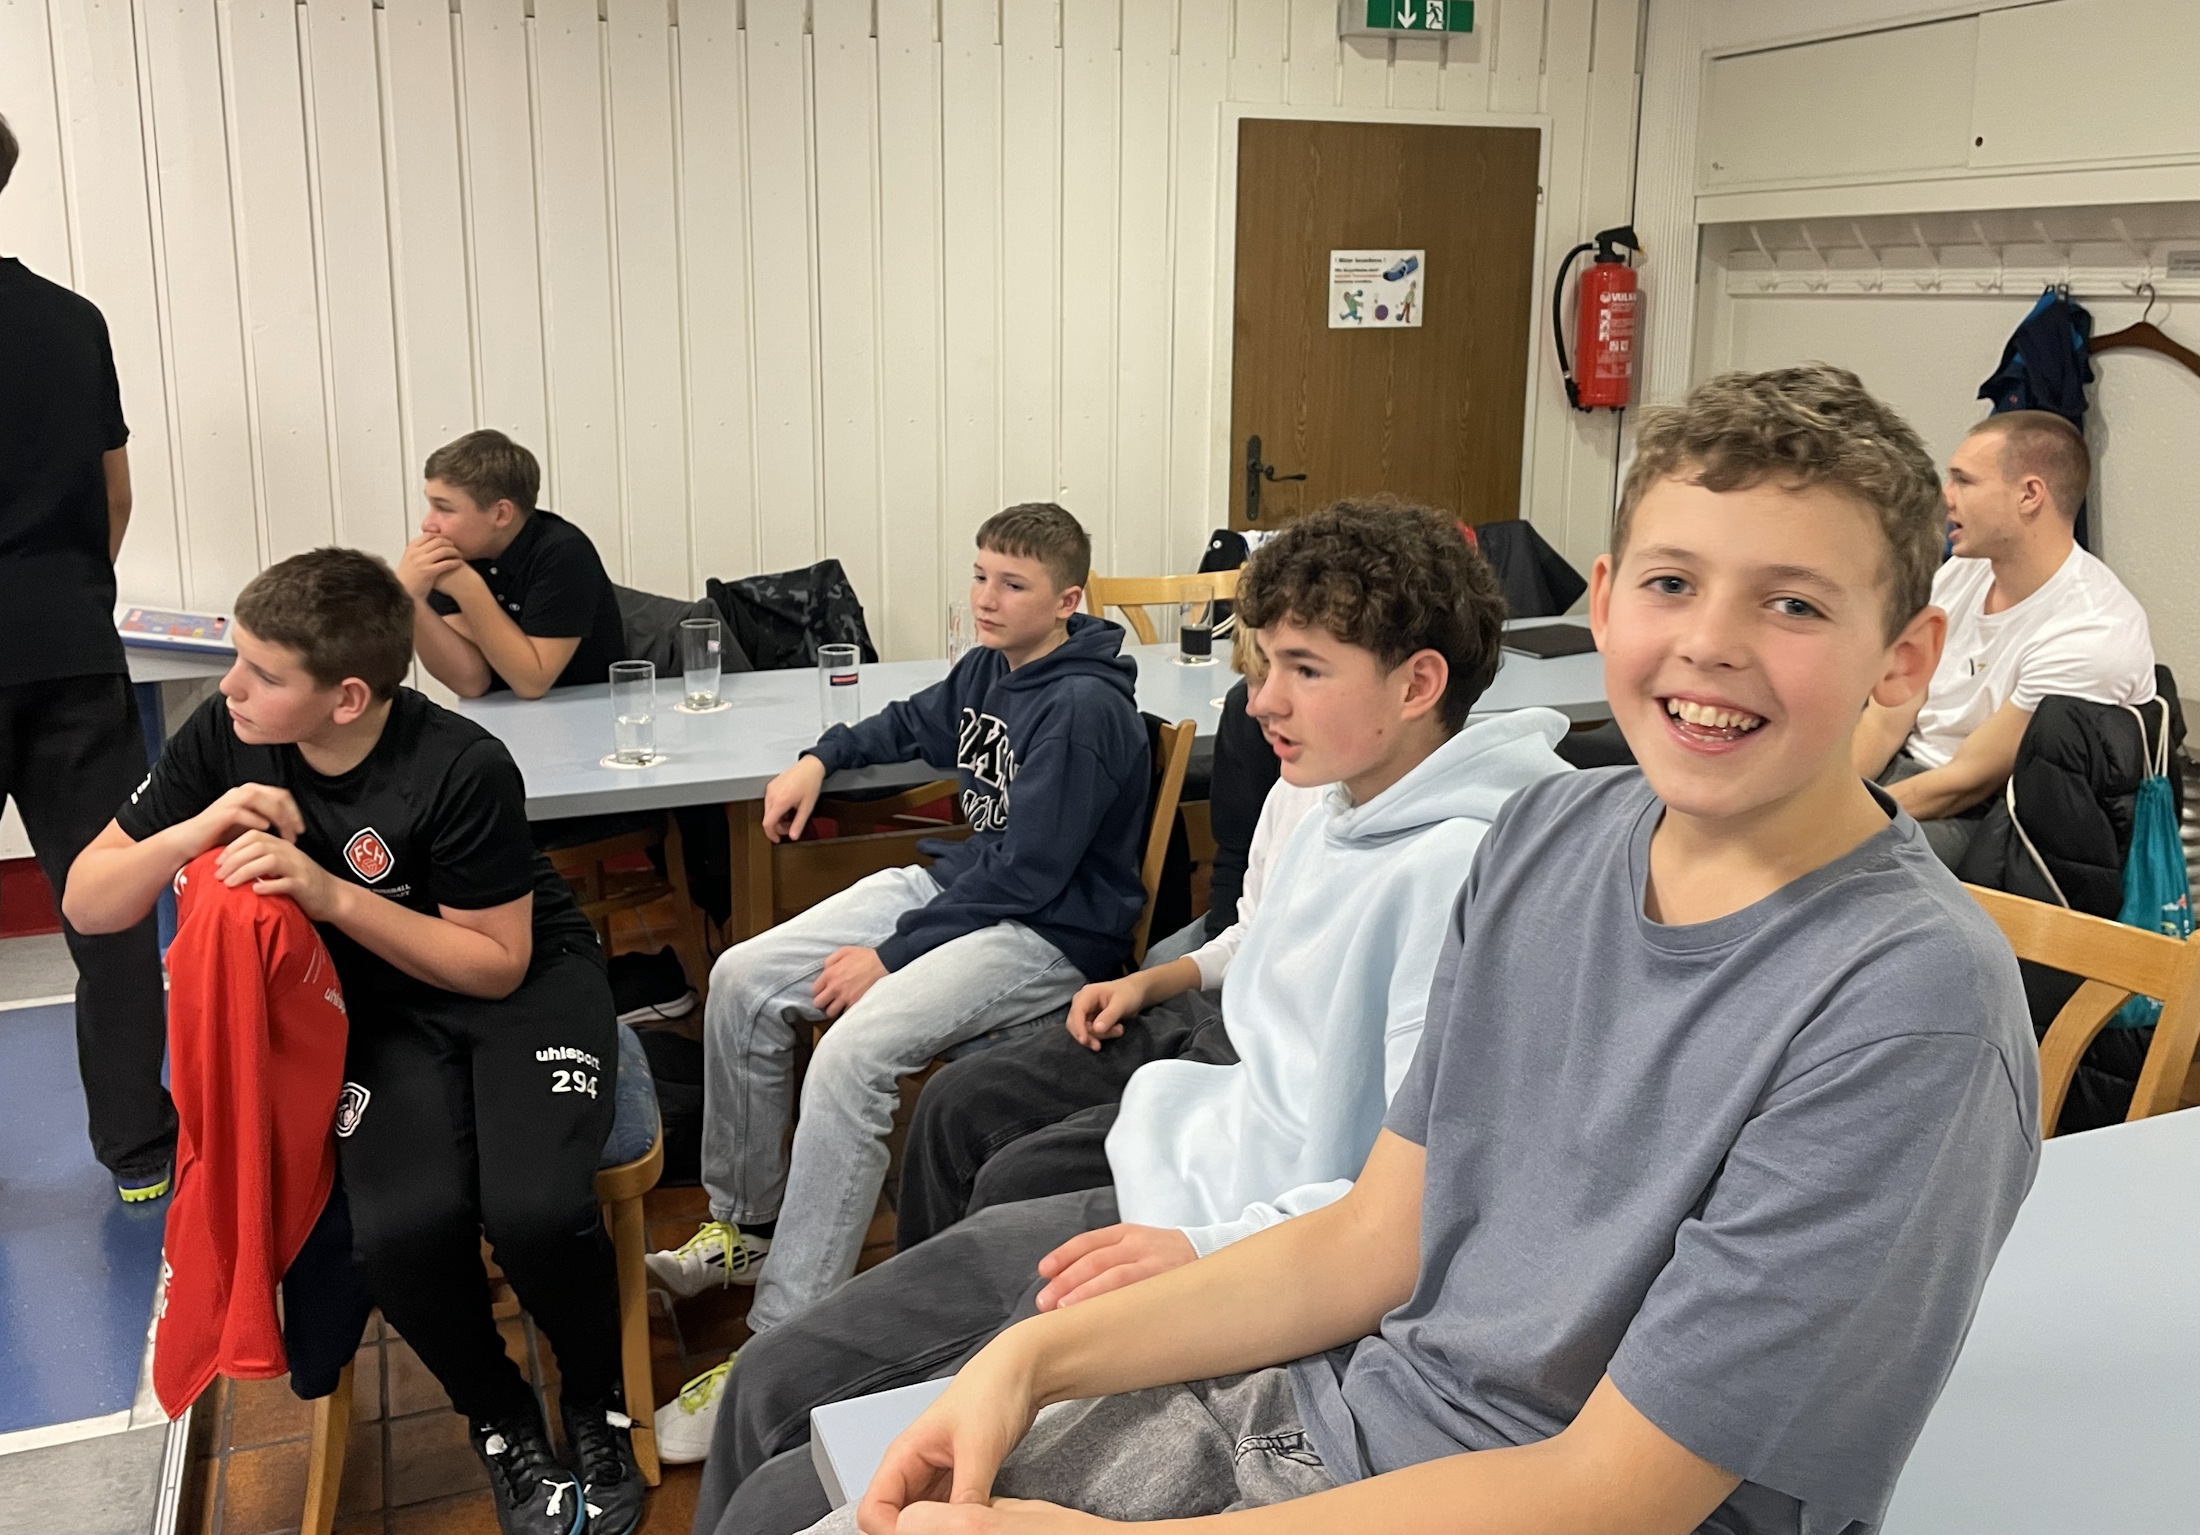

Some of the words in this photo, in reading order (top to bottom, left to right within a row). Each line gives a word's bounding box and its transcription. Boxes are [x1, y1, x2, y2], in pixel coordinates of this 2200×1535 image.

[354, 838, 385, 865] FCH
[535, 1046, 601, 1071] uhlsport
[551, 1069, 599, 1100] 294
